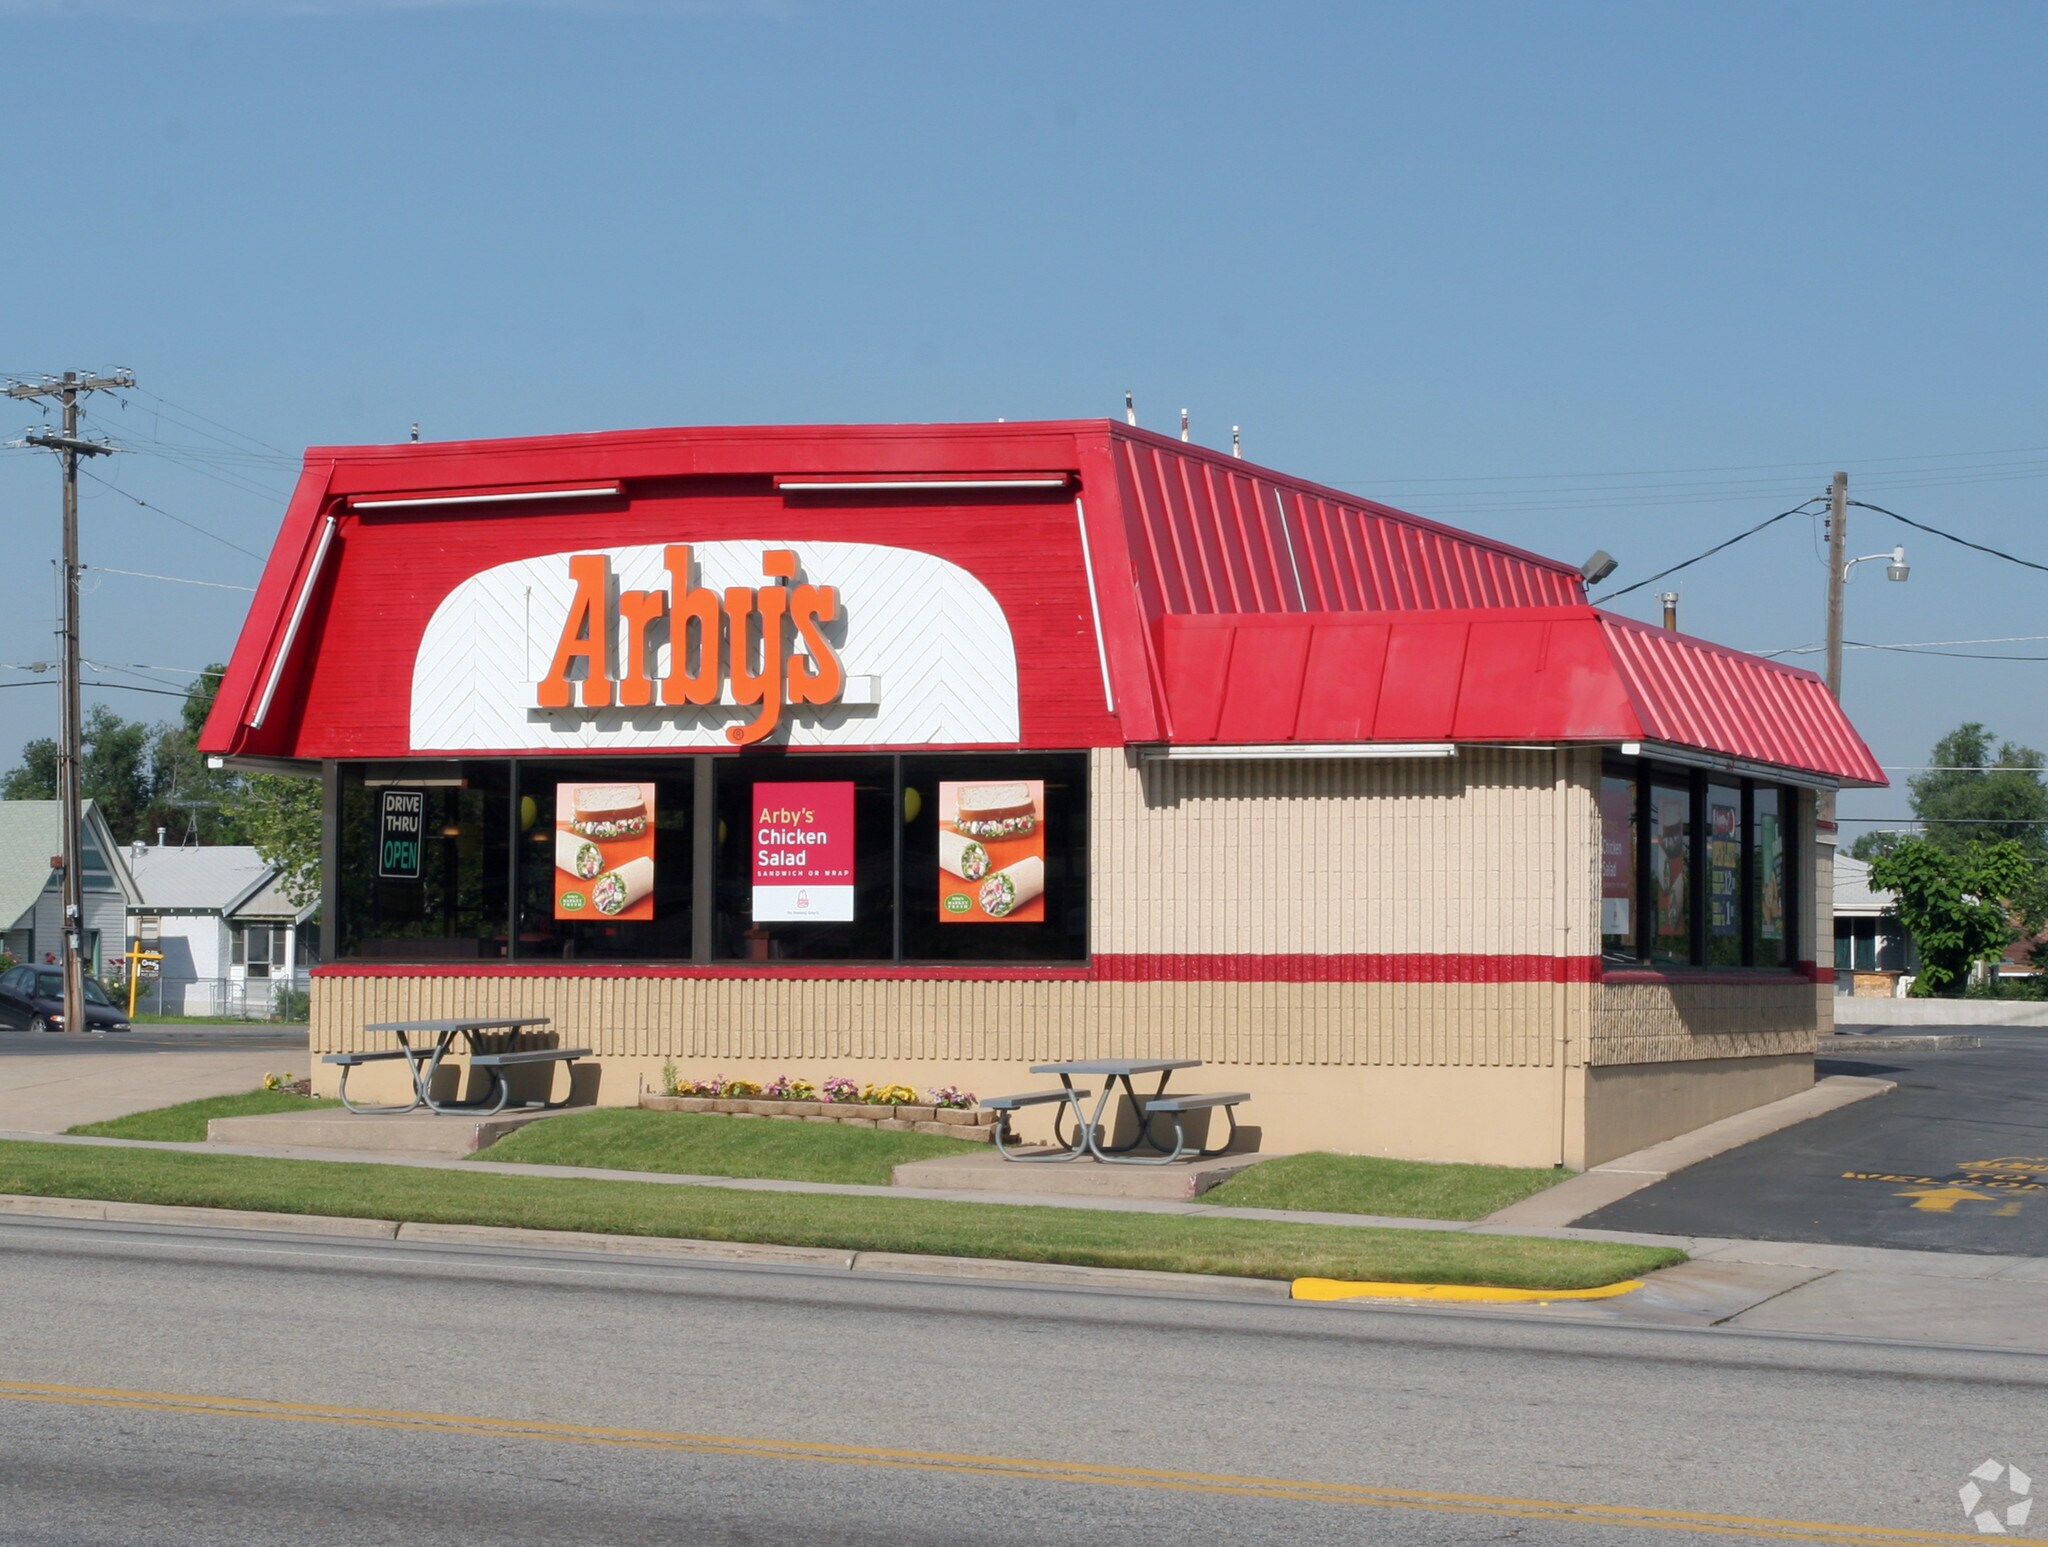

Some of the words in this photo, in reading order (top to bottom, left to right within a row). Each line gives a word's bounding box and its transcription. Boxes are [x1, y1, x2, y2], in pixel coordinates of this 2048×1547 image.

[537, 544, 845, 744] Arby's
[386, 795, 419, 812] DRIVE
[386, 815, 418, 832] THRU
[759, 807, 814, 826] Arby's
[758, 828, 827, 845] Chicken
[384, 840, 417, 869] OPEN
[758, 849, 806, 866] Salad
